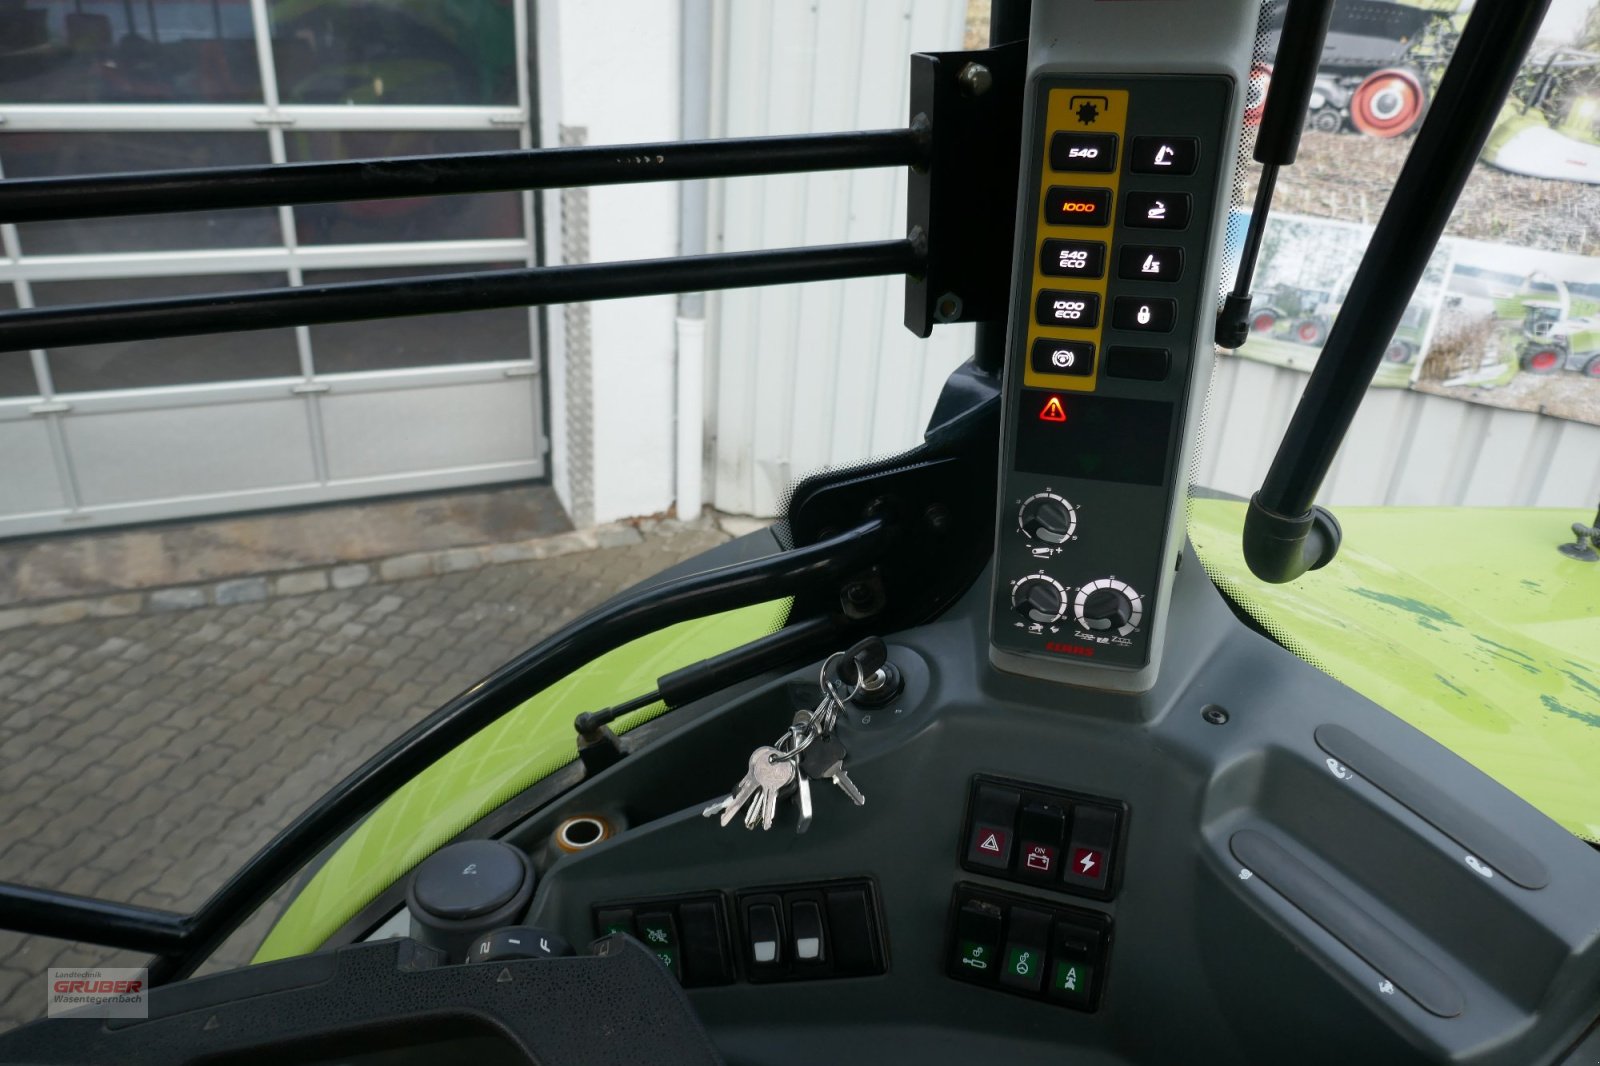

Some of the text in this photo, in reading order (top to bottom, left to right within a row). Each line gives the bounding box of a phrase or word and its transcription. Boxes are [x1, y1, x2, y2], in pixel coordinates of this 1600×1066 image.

[1068, 148, 1099, 159] 540
[1062, 202, 1096, 213] 1000
[1059, 250, 1088, 260] 540
[1059, 259, 1086, 269] ECO
[1053, 300, 1085, 311] 1000
[1054, 310, 1081, 319] ECO
[1034, 846, 1046, 854] ON
[540, 938, 551, 952] F
[1067, 967, 1077, 978] A
